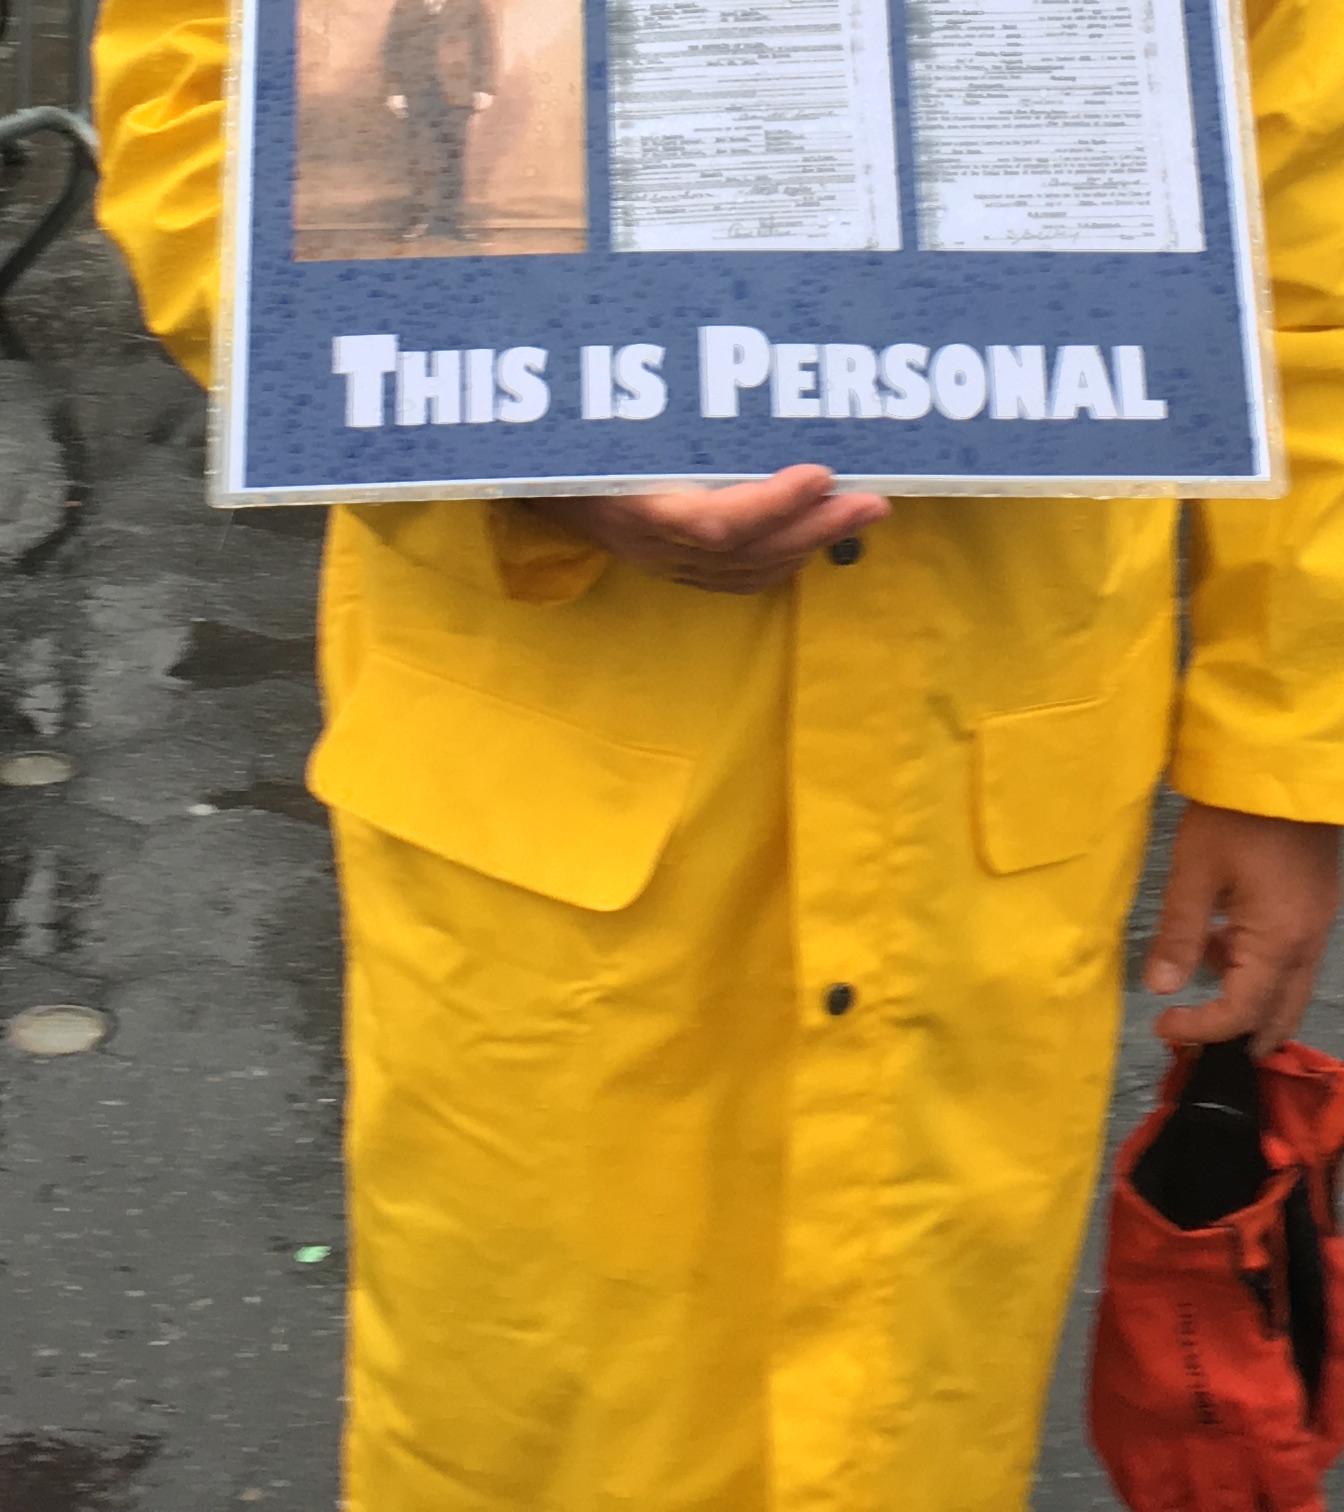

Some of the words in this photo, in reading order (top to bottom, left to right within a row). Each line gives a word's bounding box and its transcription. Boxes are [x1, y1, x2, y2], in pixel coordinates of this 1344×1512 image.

[332, 334, 550, 427] THIS
[580, 343, 668, 420] IS
[697, 325, 1169, 420] PERSONAL
